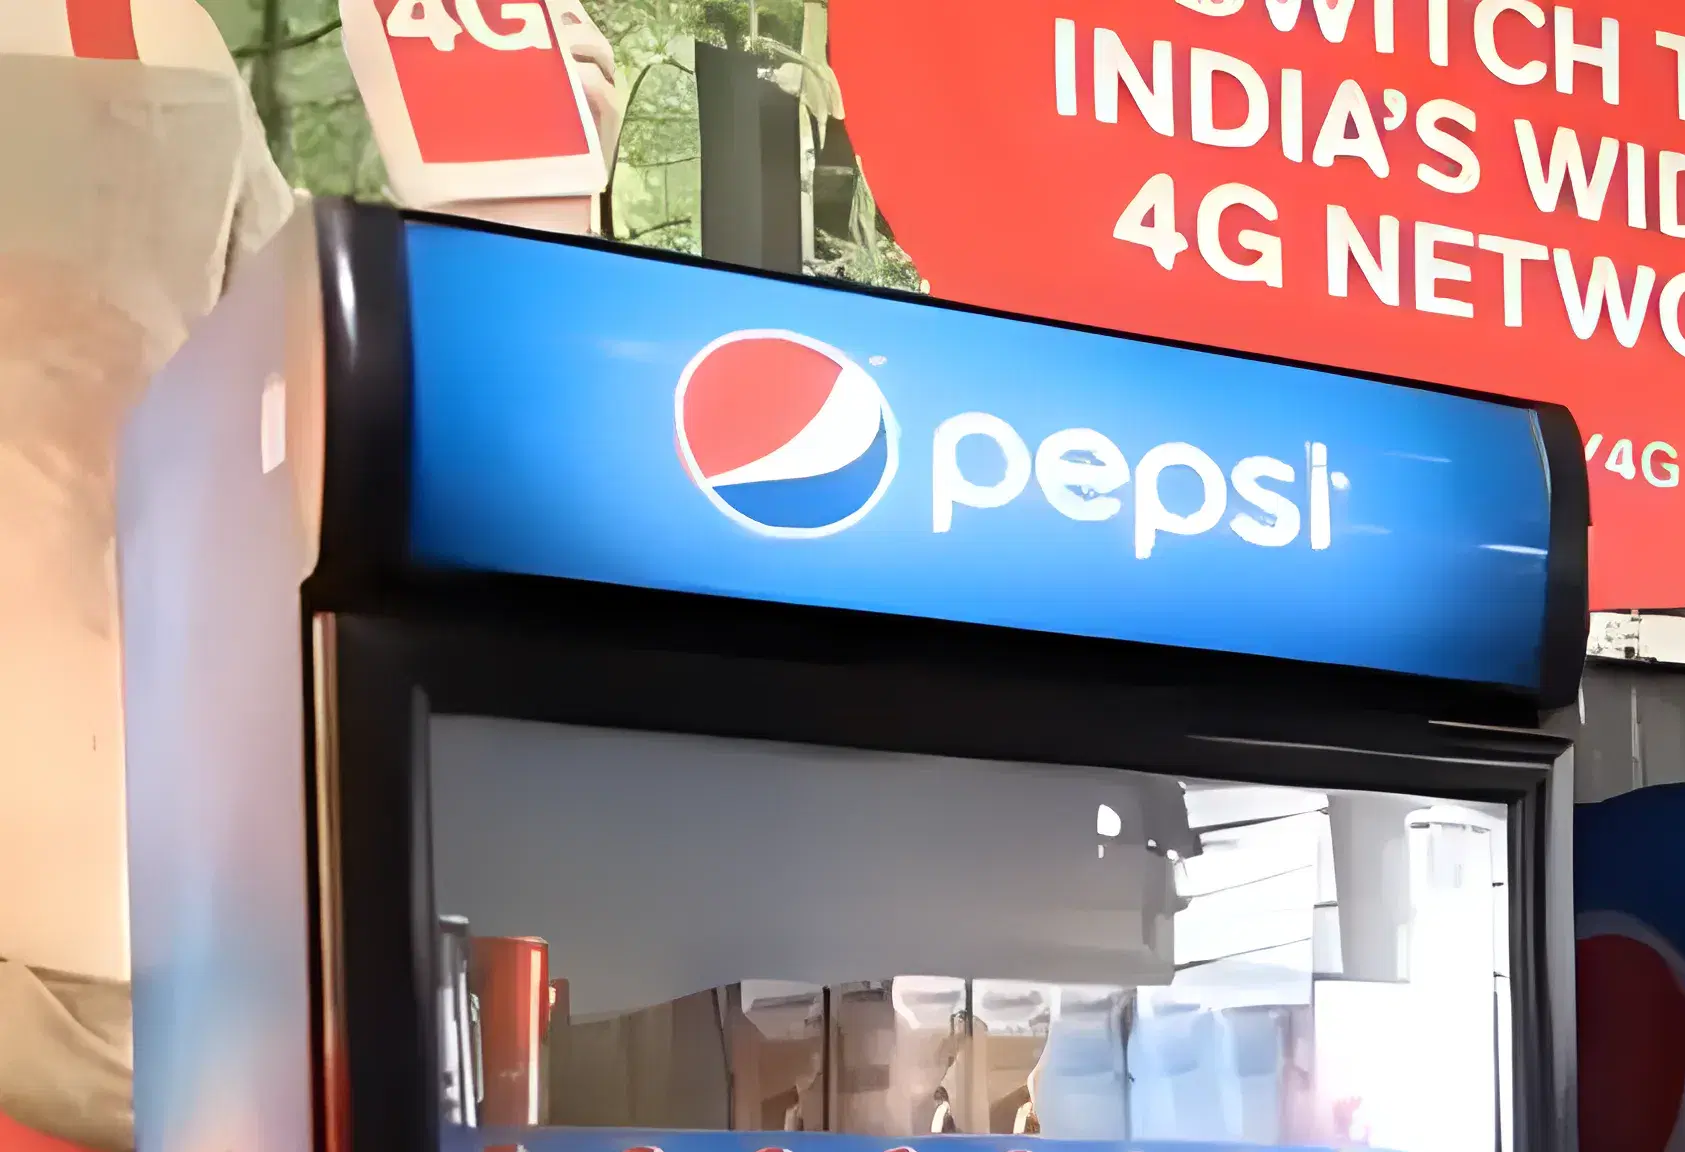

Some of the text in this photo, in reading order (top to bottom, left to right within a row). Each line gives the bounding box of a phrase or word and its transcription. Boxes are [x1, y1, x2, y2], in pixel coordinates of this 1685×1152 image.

[386, 0, 552, 51] 4G
[1174, 0, 1619, 104] WITCH
[1055, 18, 1481, 194] INDIA'S
[1112, 172, 1283, 289] 4G
[932, 411, 1332, 559] pepsi
